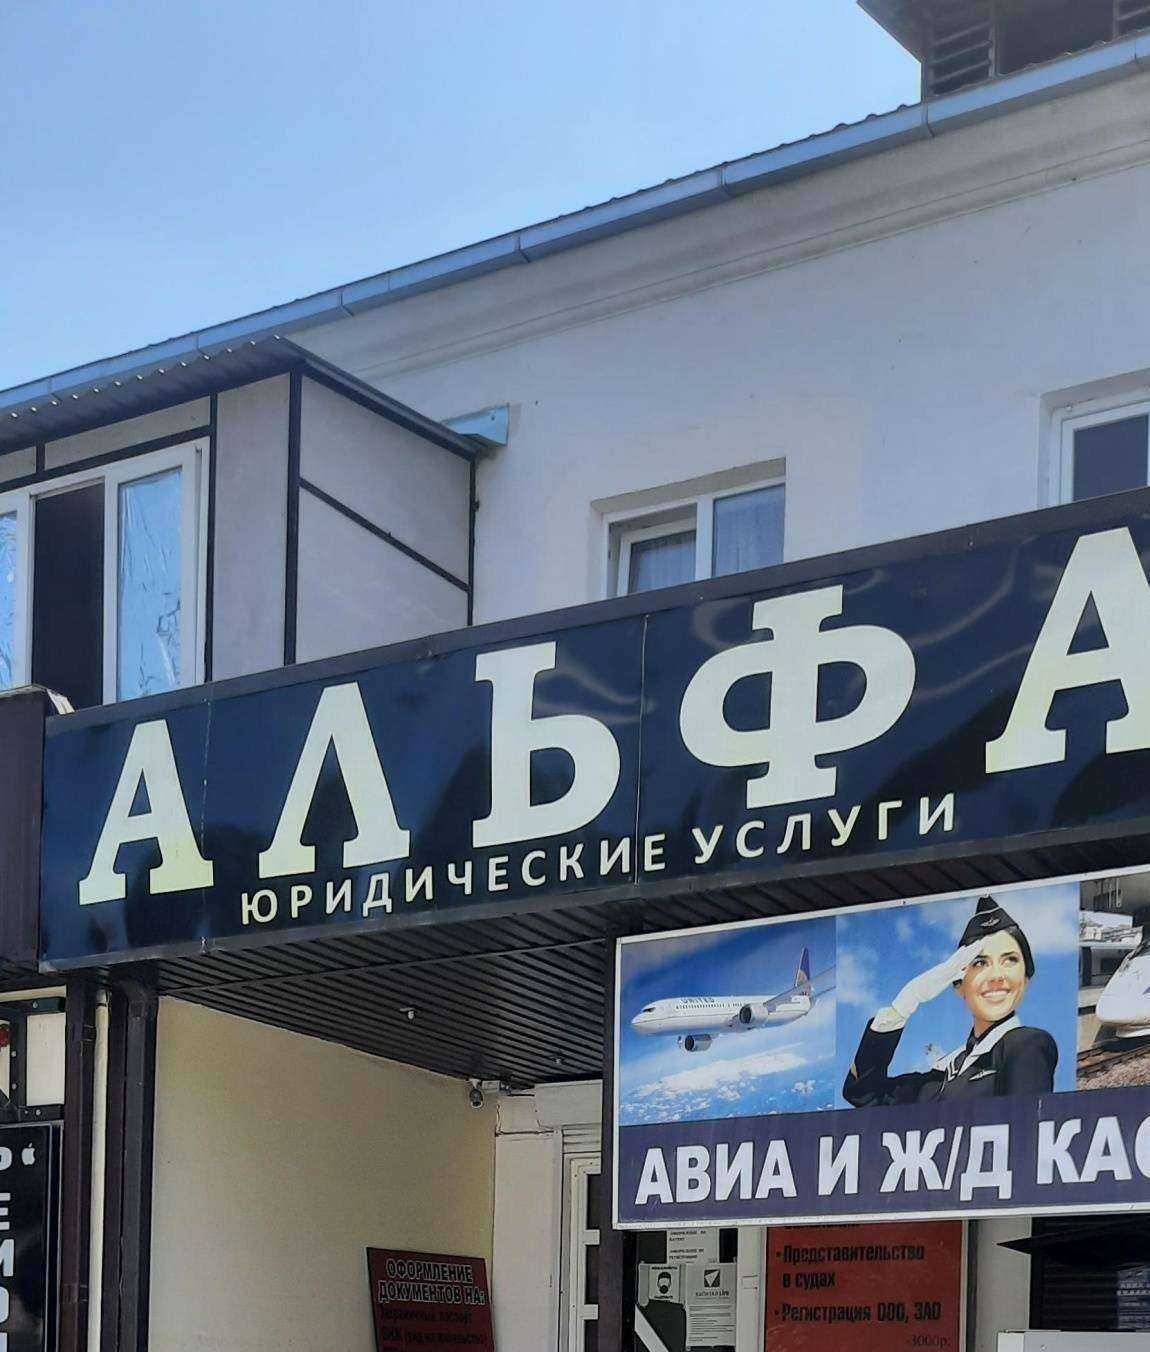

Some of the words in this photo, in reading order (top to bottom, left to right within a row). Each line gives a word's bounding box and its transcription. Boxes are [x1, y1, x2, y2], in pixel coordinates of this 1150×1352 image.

[79, 527, 1150, 905] АЛЬФА
[241, 834, 666, 925] ЮРИДИЧЕСКИЕ
[692, 793, 955, 864] УСЛУГИ
[635, 1140, 797, 1205] АВИА
[818, 1134, 859, 1196] И
[880, 1124, 1013, 1201] Ж/Д
[783, 1244, 925, 1265] Представительство
[386, 1258, 474, 1284] ОФОРМЛЕНИЕ
[783, 1275, 790, 1288] в
[795, 1272, 836, 1291] судах
[378, 1280, 463, 1304] ДОКУМЕНТОВ
[782, 1303, 871, 1324] Регистрация
[914, 1302, 941, 1321] ЗАО
